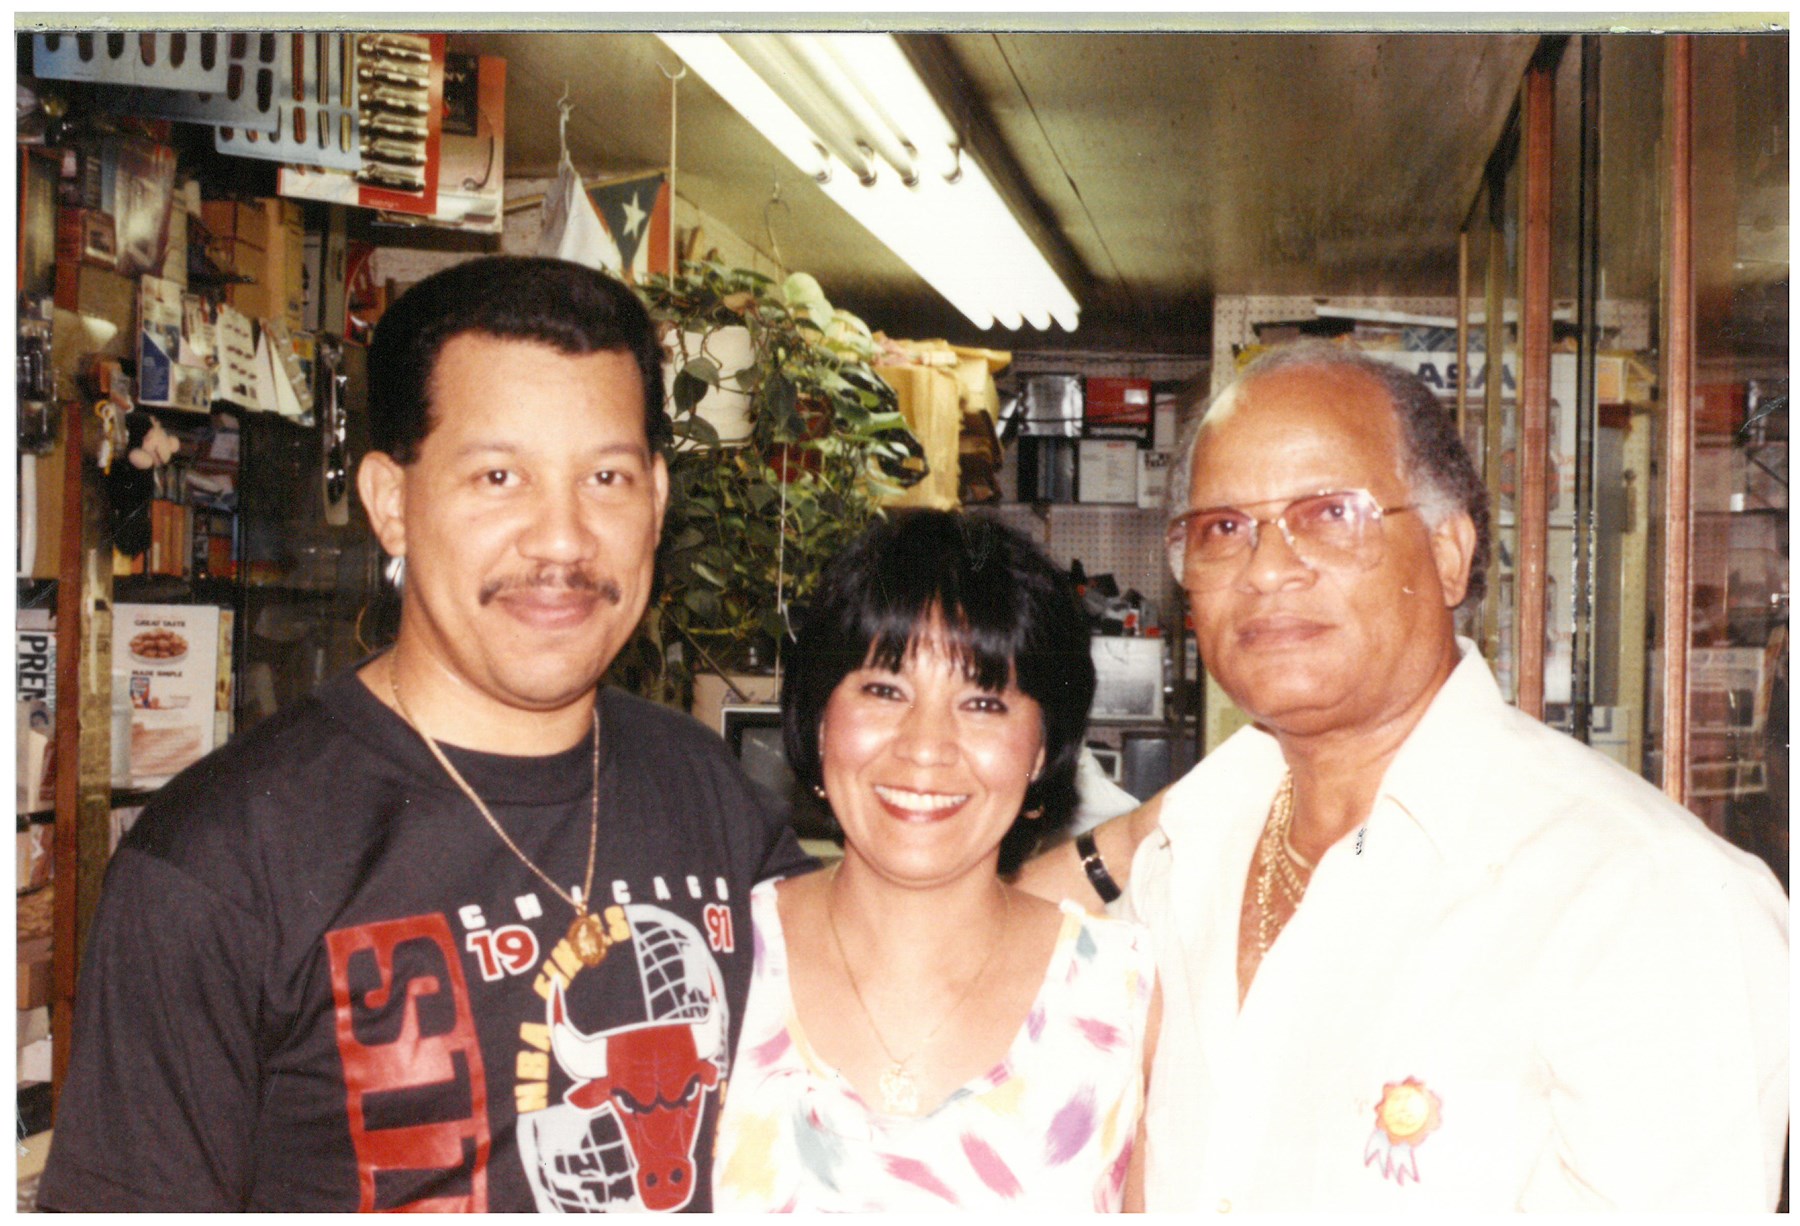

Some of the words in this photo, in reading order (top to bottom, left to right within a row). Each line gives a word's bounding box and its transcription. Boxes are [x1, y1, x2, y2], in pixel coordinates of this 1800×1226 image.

[466, 924, 540, 983] 19
[703, 902, 735, 954] 91
[514, 1021, 551, 1114] NBA
